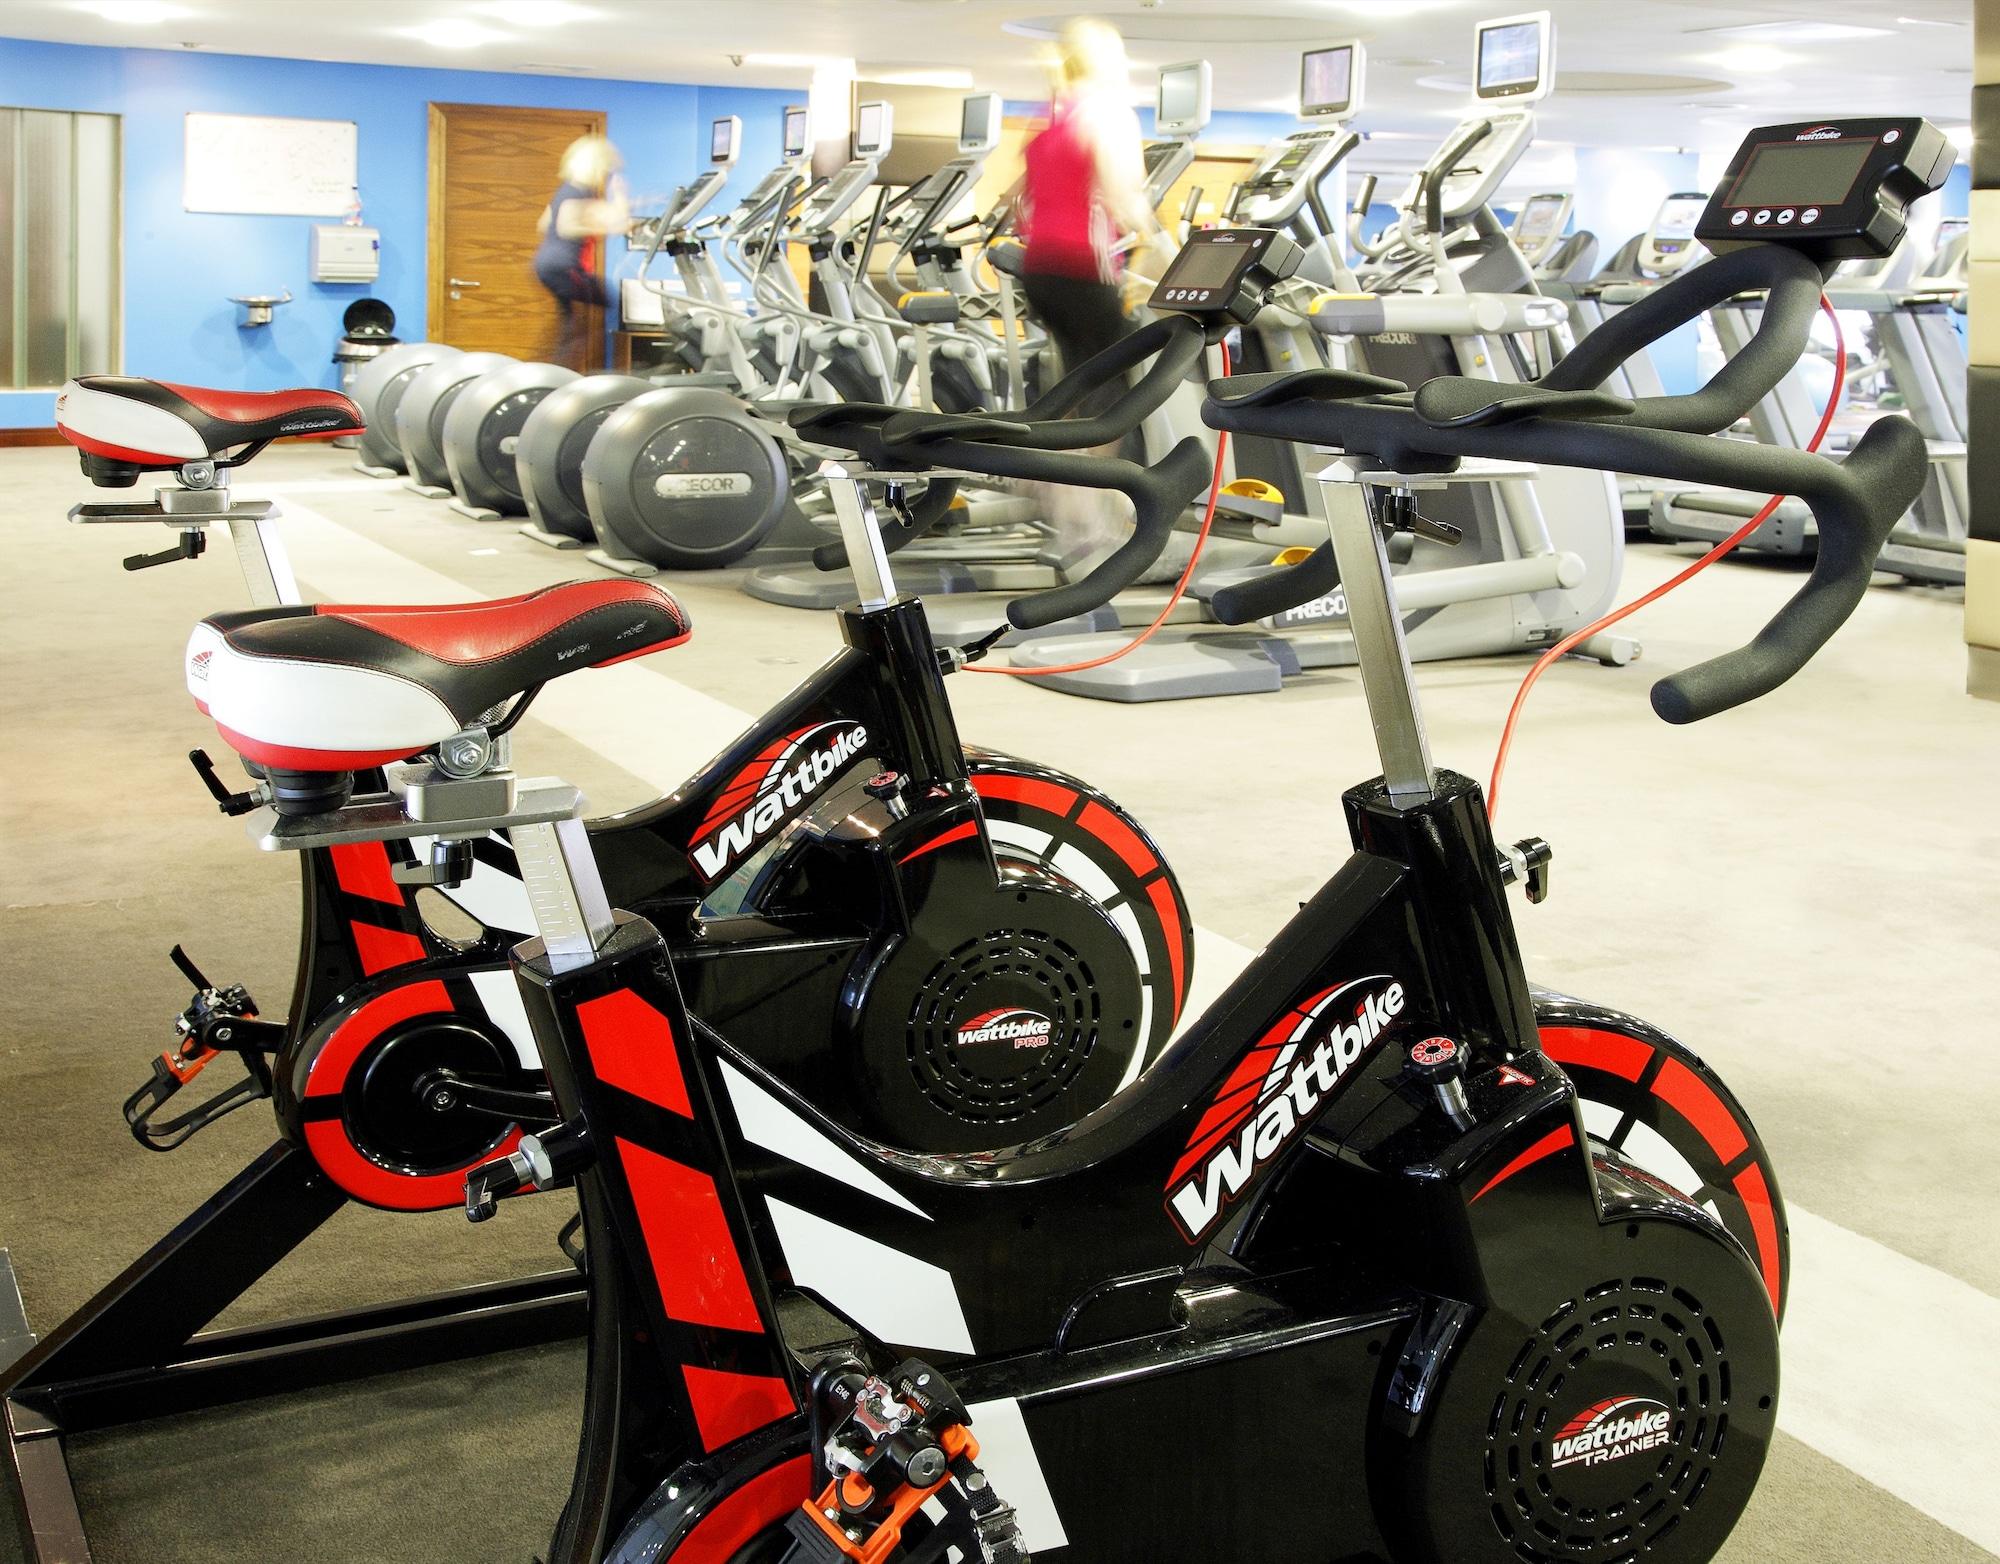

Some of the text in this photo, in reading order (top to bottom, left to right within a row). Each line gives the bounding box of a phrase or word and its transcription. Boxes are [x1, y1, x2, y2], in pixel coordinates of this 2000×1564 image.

[1285, 595, 1348, 621] PRECO
[692, 725, 868, 879] wattbike
[957, 1019, 1051, 1045] wattbike
[1014, 1035, 1049, 1049] PRO
[1171, 982, 1405, 1237] wattbike
[1552, 1410, 1670, 1460] wattbike
